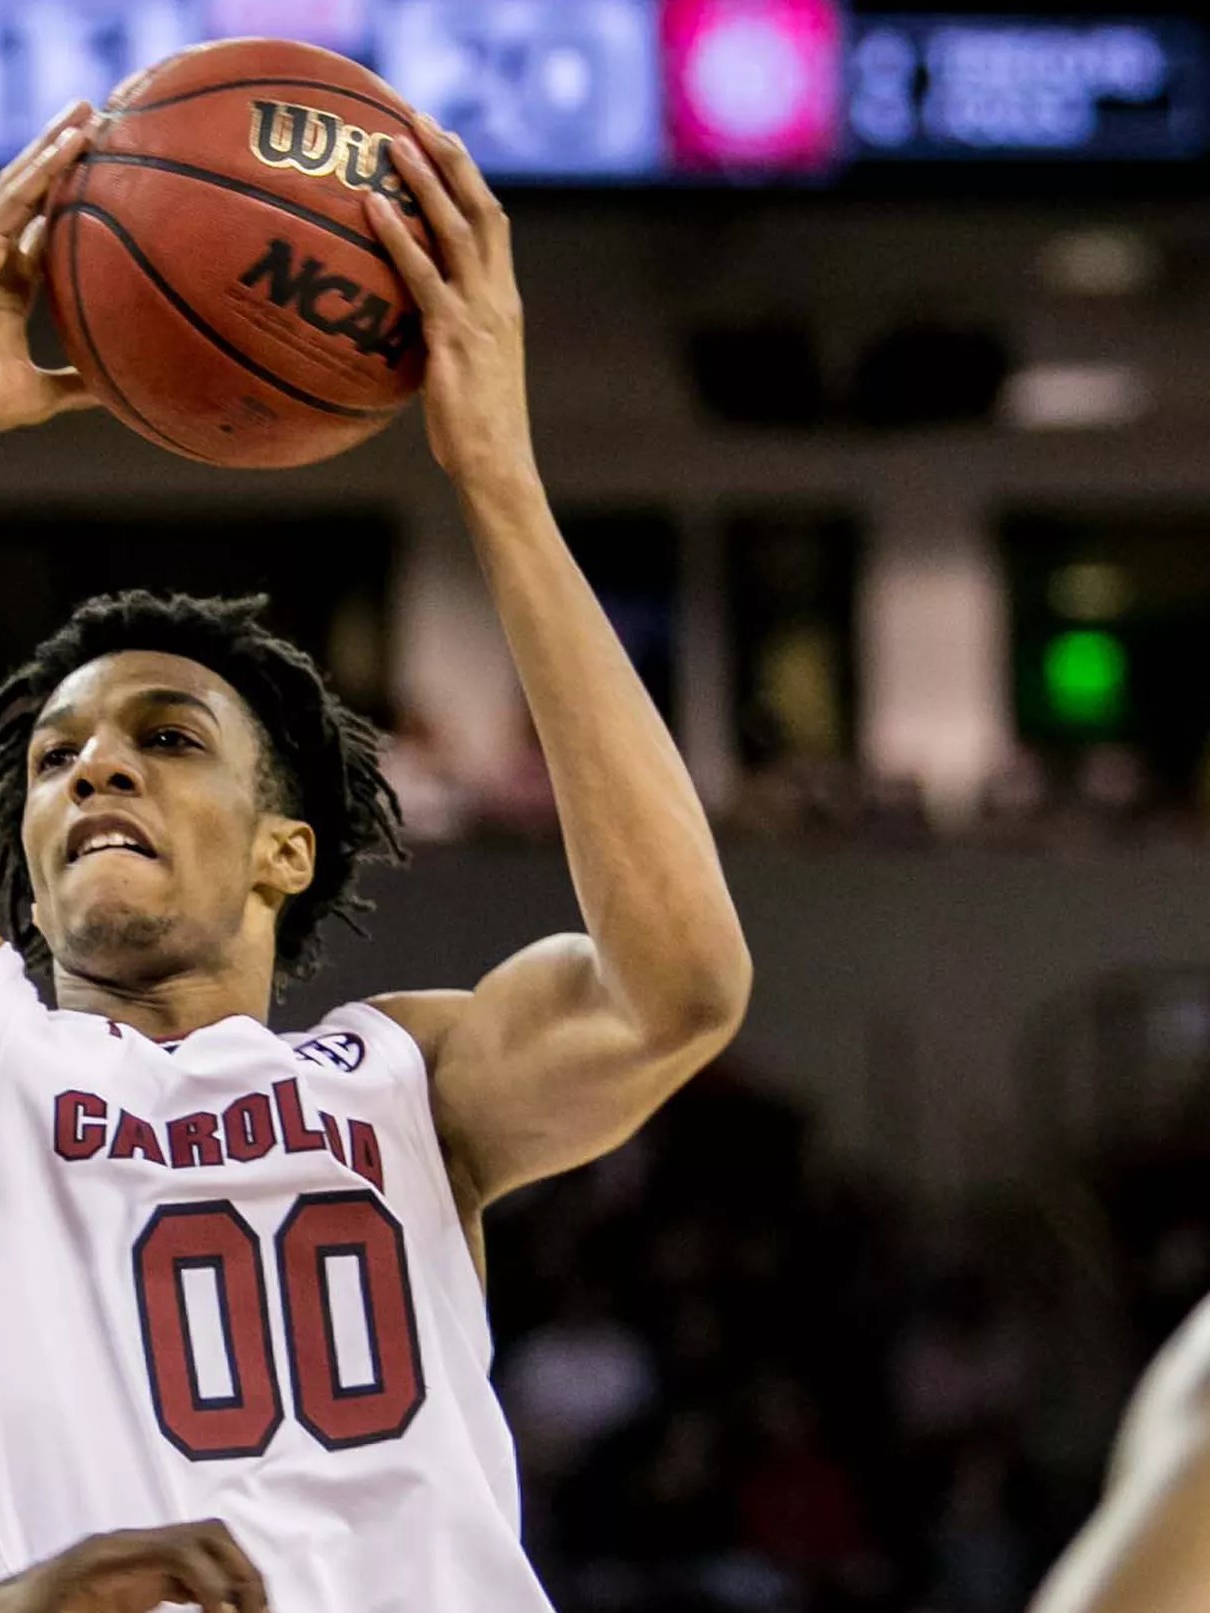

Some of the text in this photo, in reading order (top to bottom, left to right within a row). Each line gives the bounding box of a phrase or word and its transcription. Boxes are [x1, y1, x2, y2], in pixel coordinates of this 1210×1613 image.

[249, 100, 424, 217] Wil
[53, 1077, 385, 1196] CAROLA
[132, 1189, 426, 1462] 00
